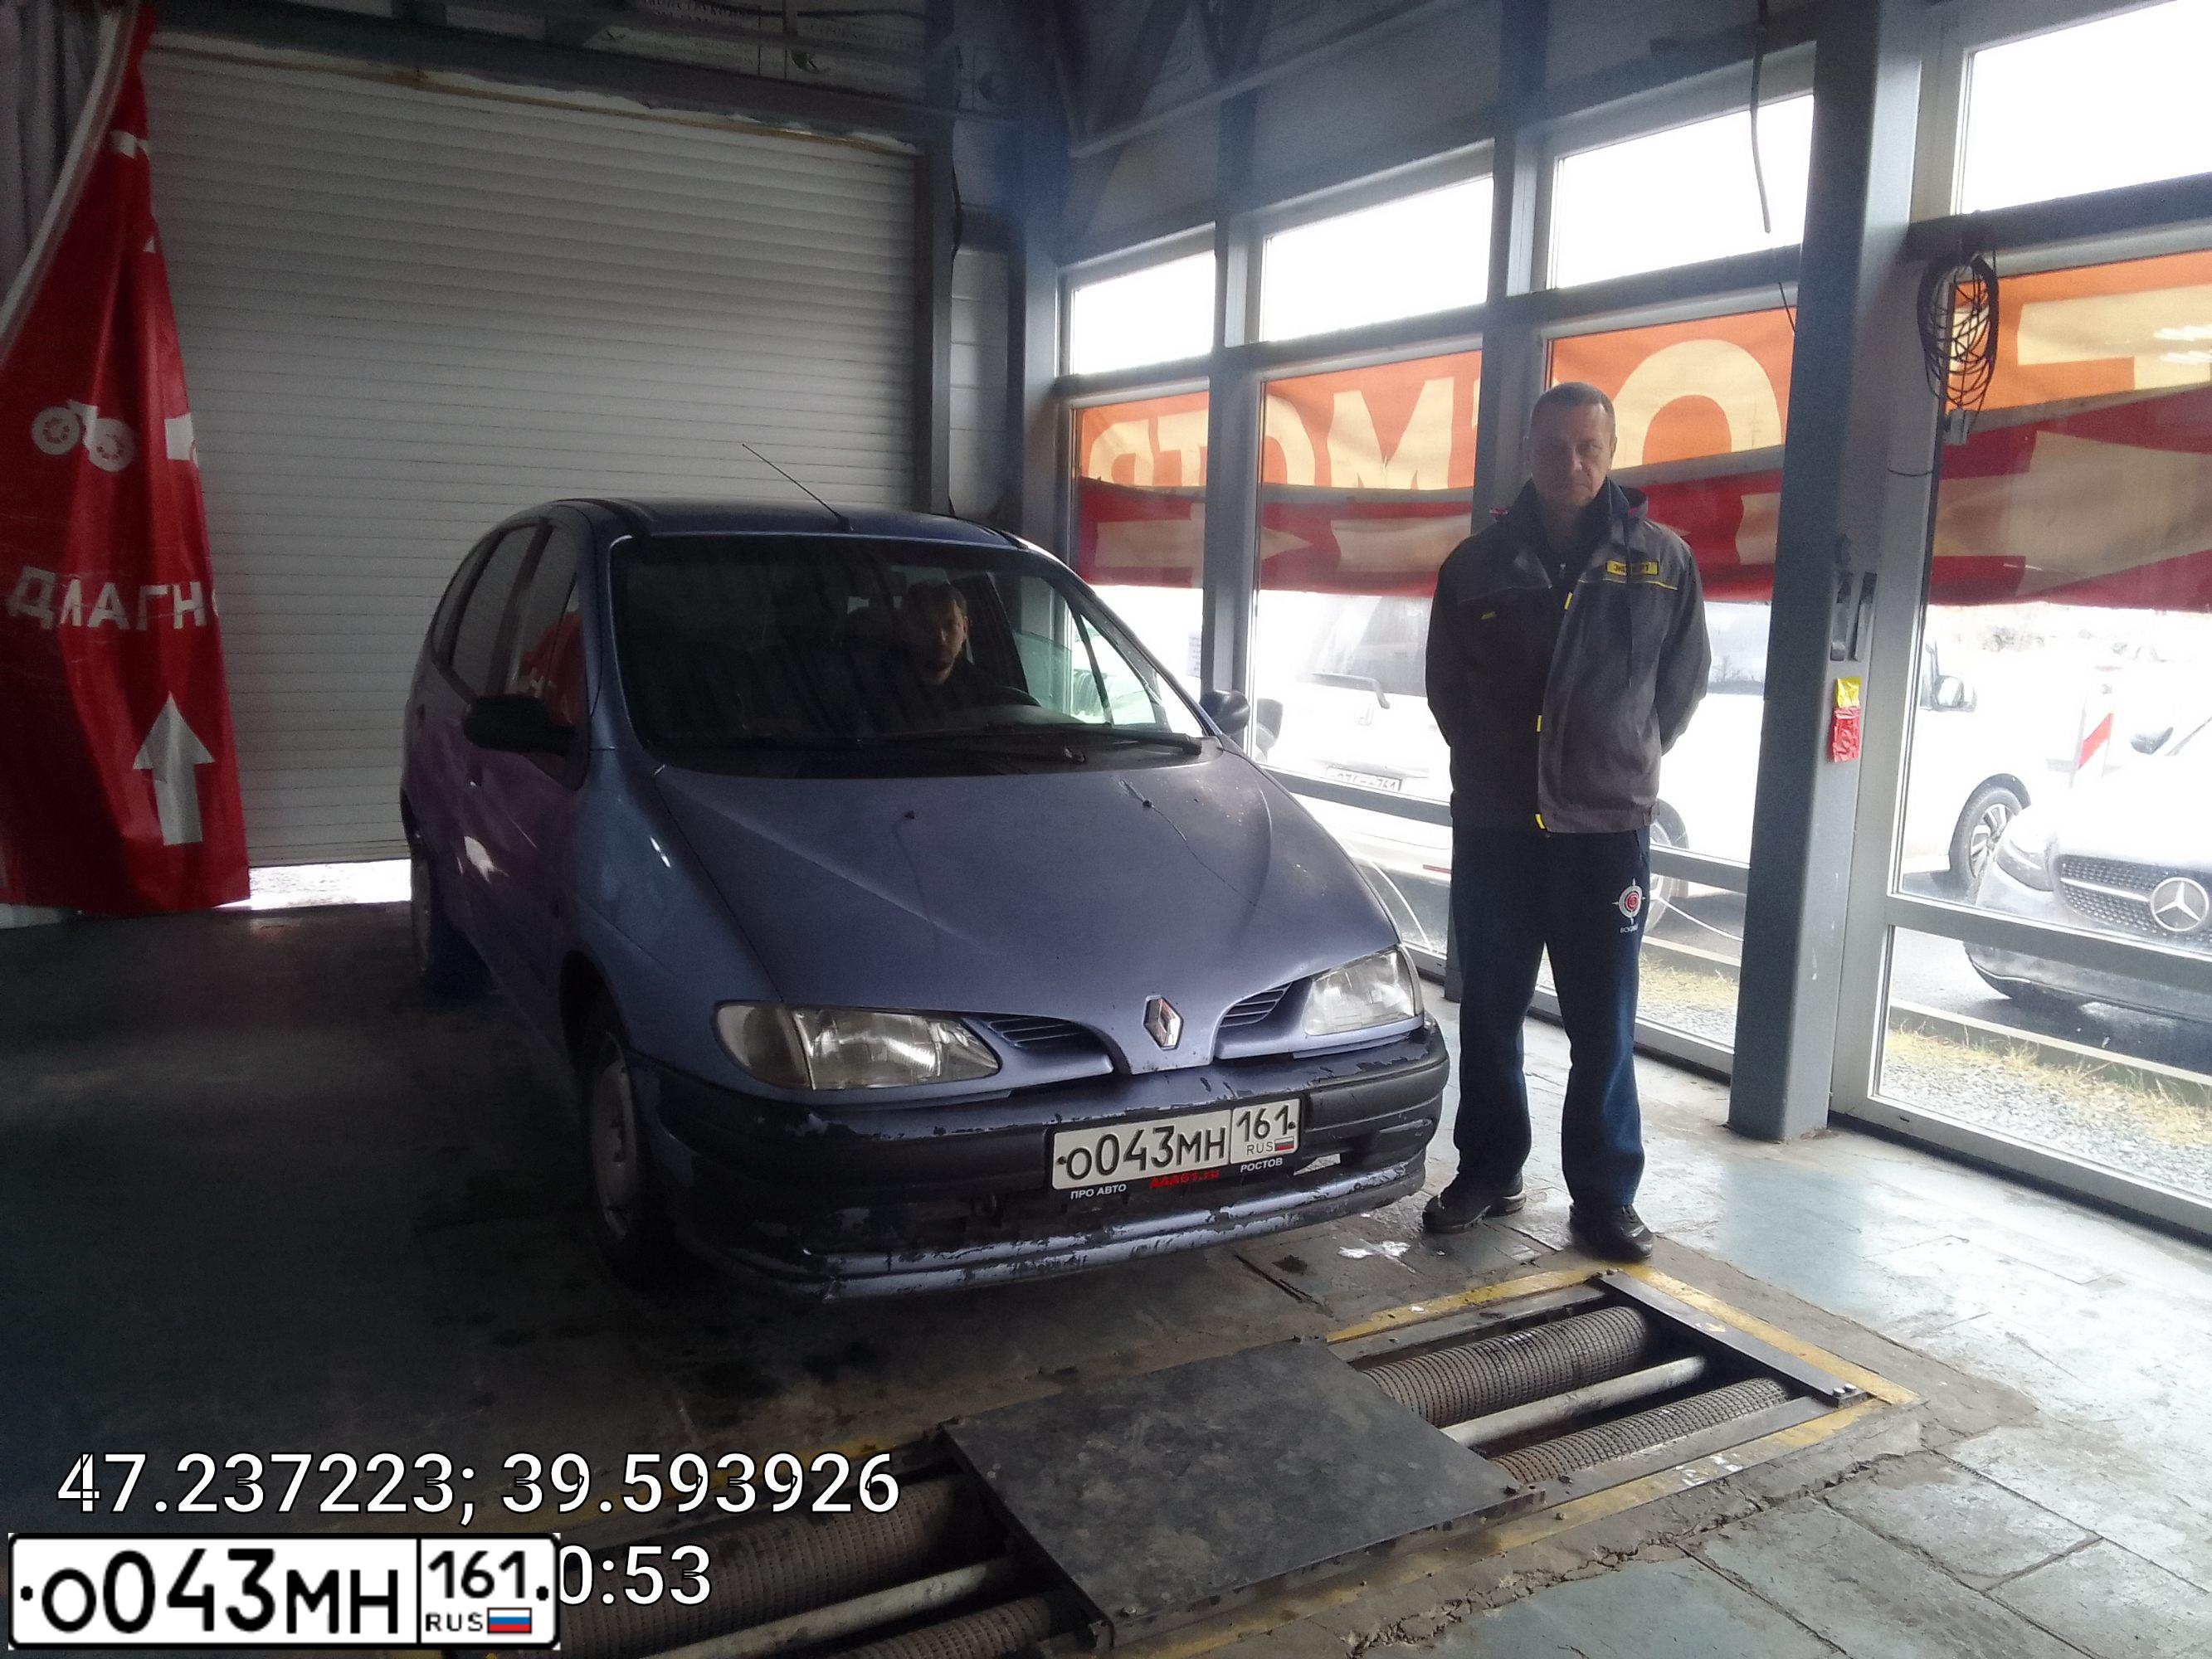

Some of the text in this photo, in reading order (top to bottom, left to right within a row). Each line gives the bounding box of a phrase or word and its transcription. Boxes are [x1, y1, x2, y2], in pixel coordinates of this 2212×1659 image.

[7, 566, 218, 630] ДИАГН
[1236, 1105, 1289, 1142] 161
[1246, 1141, 1274, 1155] RUS
[1240, 1157, 1284, 1173] РОСТОВ
[1070, 1184, 1127, 1199] ПРО АВТО
